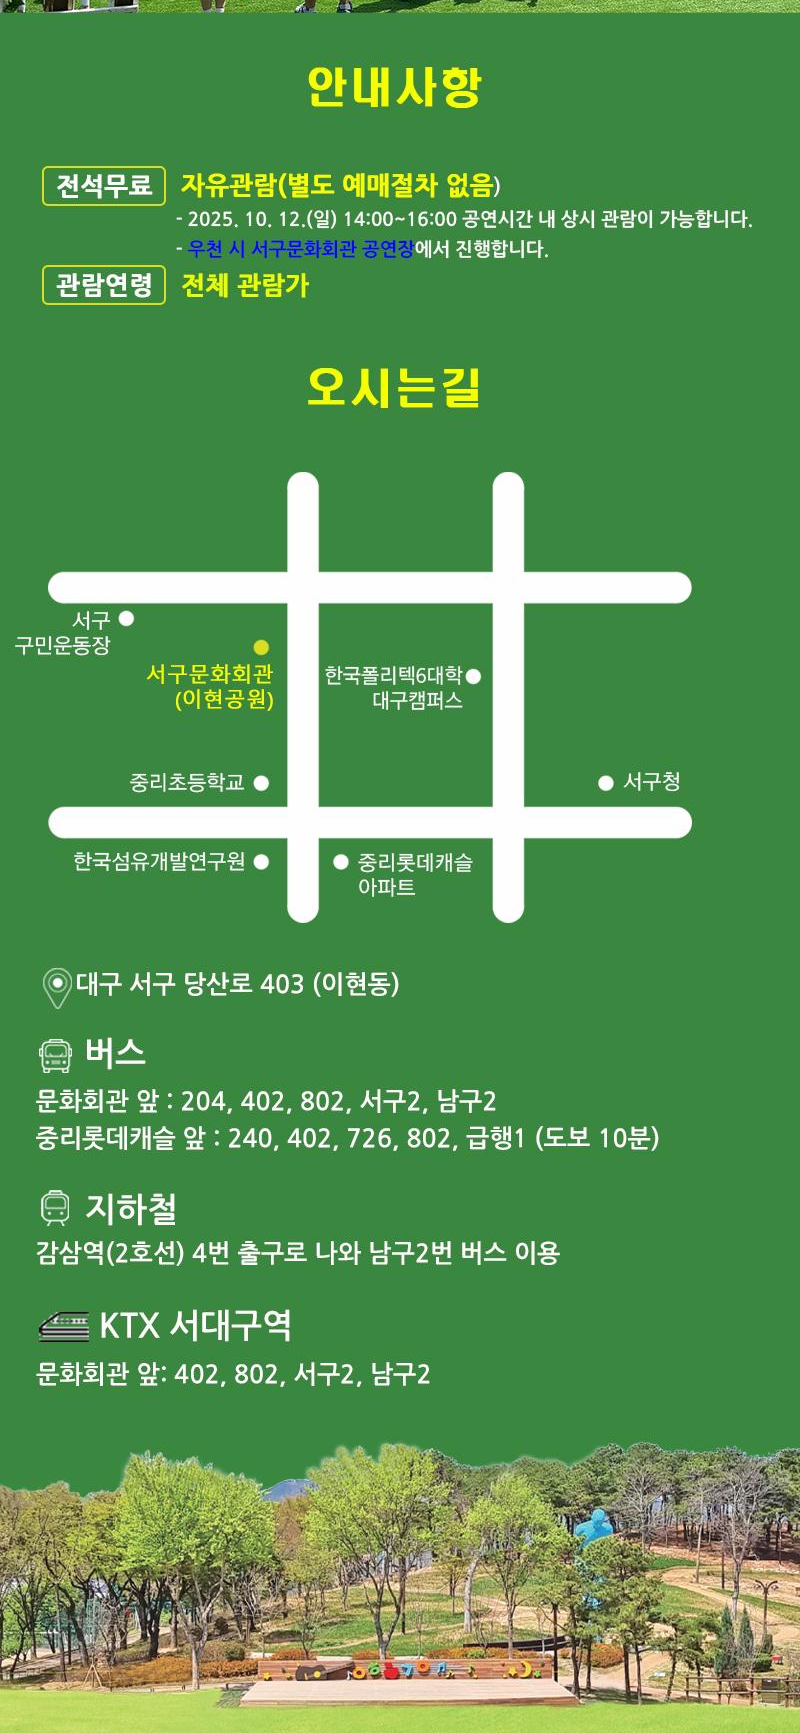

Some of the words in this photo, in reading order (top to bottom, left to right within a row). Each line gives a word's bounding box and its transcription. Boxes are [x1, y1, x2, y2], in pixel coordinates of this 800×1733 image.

[307, 66, 483, 109] 안내사항
[56, 173, 154, 200] 전석무료
[342, 172, 439, 199] 예매절차
[446, 172, 501, 199] 없음)
[187, 210, 239, 228] 2025.
[245, 210, 273, 229] 10.
[461, 209, 534, 229] 공연시간
[538, 209, 556, 229] 내
[560, 209, 595, 230] 상시
[600, 209, 653, 229] 관람이
[659, 209, 753, 229] 가능합니다.
[187, 239, 223, 259] 우천
[228, 239, 245, 259] 시
[251, 239, 358, 259] 서구문화회관
[361, 239, 450, 260] 공연장에서
[455, 239, 549, 259] 진행합니다.
[55, 272, 152, 299] 관람연령
[181, 272, 229, 299] 전체
[237, 272, 310, 299] 관람가
[307, 367, 480, 409] 오시는길
[71, 610, 112, 631] 서구
[14, 635, 112, 657] 구민운동장
[146, 663, 274, 685] 서구문화회관
[324, 665, 464, 686] 한국폴리텍6대학
[175, 688, 274, 712] (이현공원)
[372, 690, 464, 711] 대구캠퍼스
[129, 772, 245, 794] 중리초등학교
[623, 771, 680, 792] 서구청
[73, 851, 245, 872] 한국섬유개발연구원
[357, 852, 474, 874] 중리롯데캐슬
[358, 877, 416, 898] 아파트
[76, 971, 123, 997] 대구
[129, 971, 177, 997] 서구
[184, 971, 254, 997] 당산로
[259, 973, 304, 995] 403
[313, 971, 400, 998] (이현동)
[86, 1036, 147, 1071] 버스
[35, 1088, 130, 1114] 문화회관
[136, 1088, 160, 1114] 앞
[181, 1090, 233, 1115] 204,
[240, 1090, 293, 1115] 402,
[300, 1090, 352, 1115] 802,
[359, 1088, 429, 1115] 서구2,
[437, 1088, 497, 1114] 남구2
[35, 1125, 177, 1151] 중리롯데캐슬
[183, 1125, 207, 1151] 앞
[228, 1127, 279, 1152] 240,
[286, 1127, 339, 1152] 402,
[347, 1127, 399, 1152] 726,
[407, 1127, 458, 1152] 802,
[465, 1125, 523, 1151] 급행1
[535, 1125, 591, 1152] (도보
[600, 1125, 660, 1152] 10분)
[85, 1192, 176, 1227] 지하철
[191, 1240, 230, 1266] 4번
[237, 1240, 308, 1266] 출구로
[315, 1240, 362, 1266] 나와
[369, 1240, 453, 1266] 남구2번
[461, 1240, 508, 1266] 버스
[515, 1240, 561, 1266] 이용
[100, 1311, 161, 1339] KTX
[169, 1308, 291, 1343] 서대구역
[35, 1361, 130, 1387] 문화회관
[137, 1361, 167, 1387] 앞:
[173, 1363, 226, 1388] 402,
[234, 1363, 286, 1388] 802,
[293, 1361, 362, 1388] 서구2,
[371, 1361, 431, 1387] 남구2
